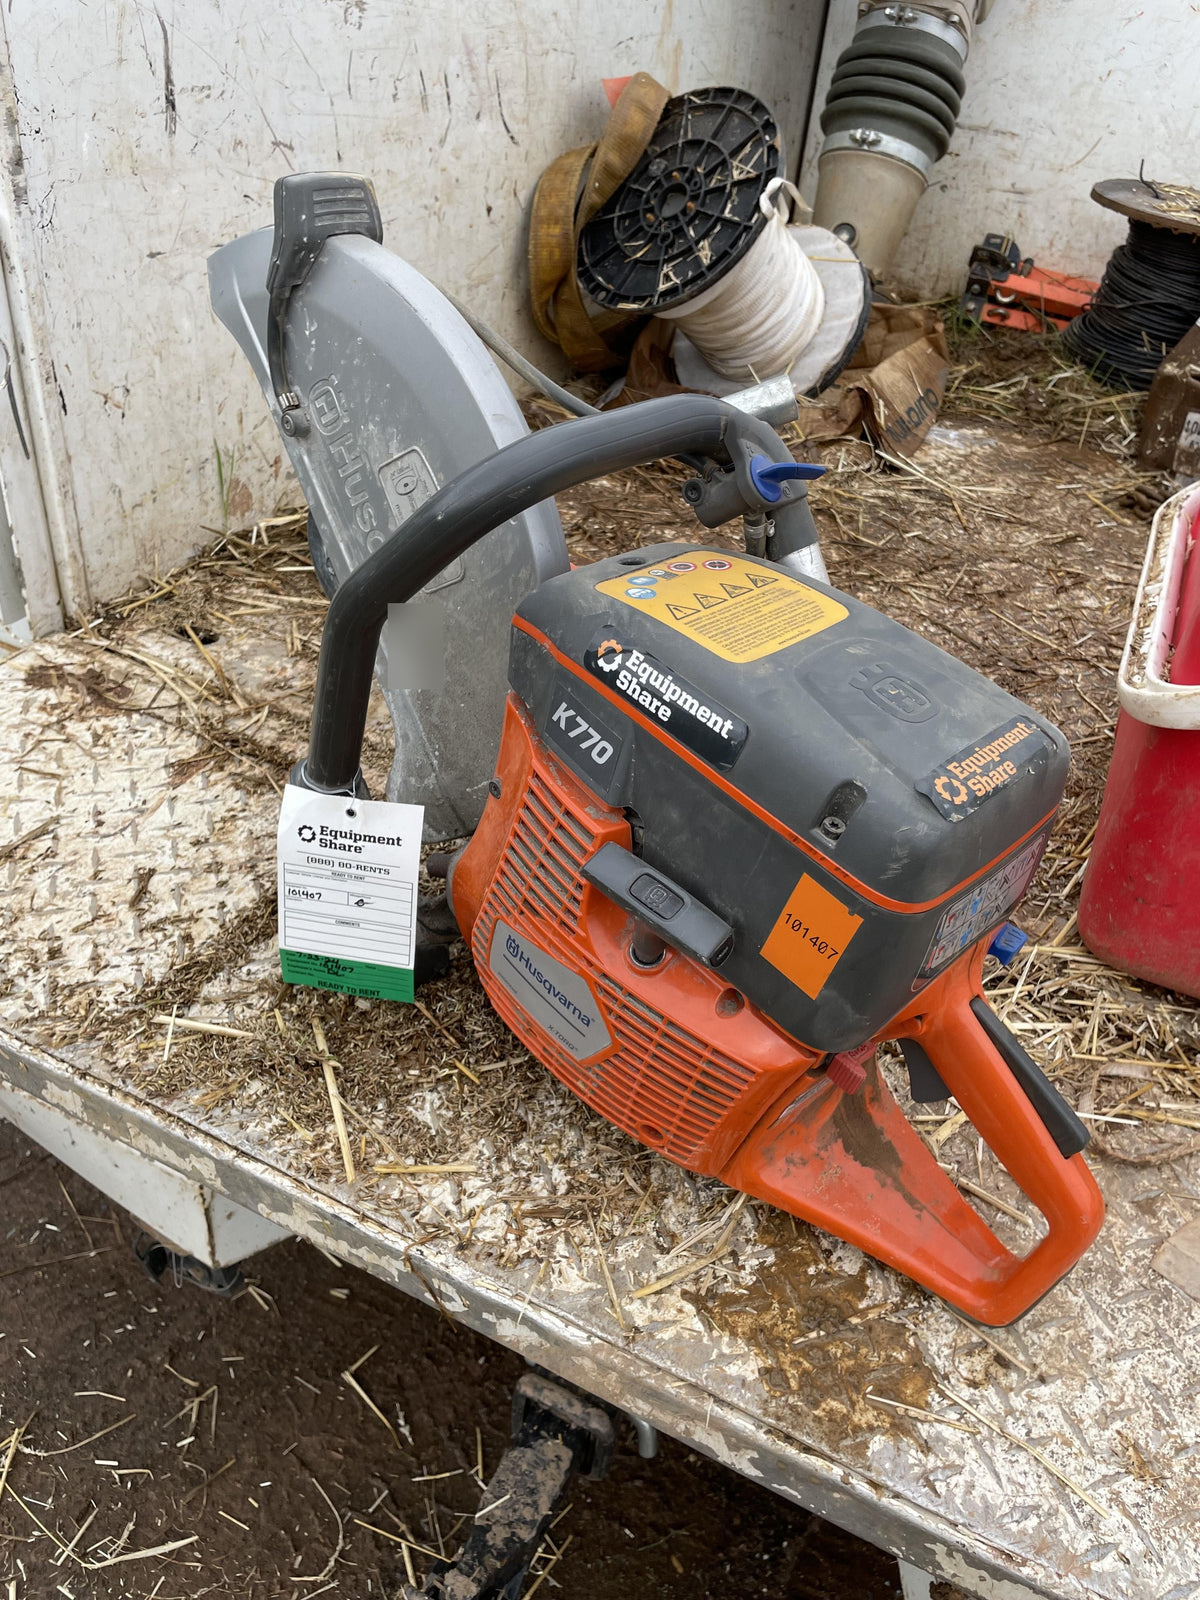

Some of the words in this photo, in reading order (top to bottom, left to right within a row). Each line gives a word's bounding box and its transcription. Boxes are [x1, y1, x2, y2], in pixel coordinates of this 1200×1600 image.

[616, 671, 672, 722] Share
[625, 650, 734, 739] Equipment
[947, 721, 1032, 780] Equipment
[967, 760, 1017, 797] Share
[319, 825, 402, 847] Equipment
[319, 839, 363, 854] Share
[288, 888, 322, 900] 101407
[785, 913, 839, 960] 101407
[318, 980, 343, 992] READY
[344, 985, 357, 995] TO
[359, 988, 381, 997] RENT
[519, 951, 591, 1028] Husqvarna
